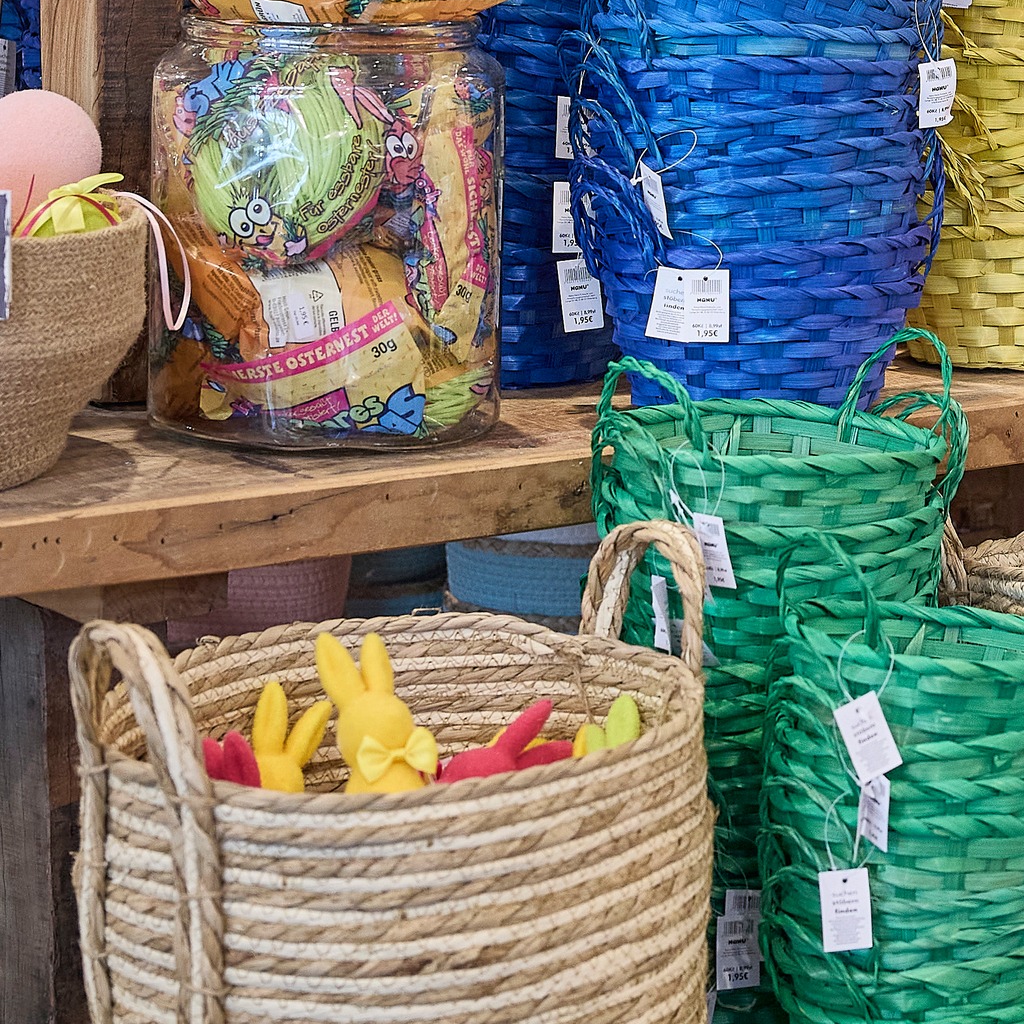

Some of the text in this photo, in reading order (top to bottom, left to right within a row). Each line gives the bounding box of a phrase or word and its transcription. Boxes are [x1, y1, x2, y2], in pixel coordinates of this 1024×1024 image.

[299, 134, 362, 221] Für essbare
[455, 284, 473, 303] 30g
[663, 295, 685, 303] stöber
[328, 310, 340, 332] GELB
[372, 308, 391, 323] DER
[574, 315, 593, 325] 1,95€
[285, 323, 369, 371] OSTERNEST
[371, 311, 399, 334] WELT!
[696, 330, 719, 338] 1,95€
[370, 336, 398, 359] 30g
[728, 972, 749, 982] 1,95€
